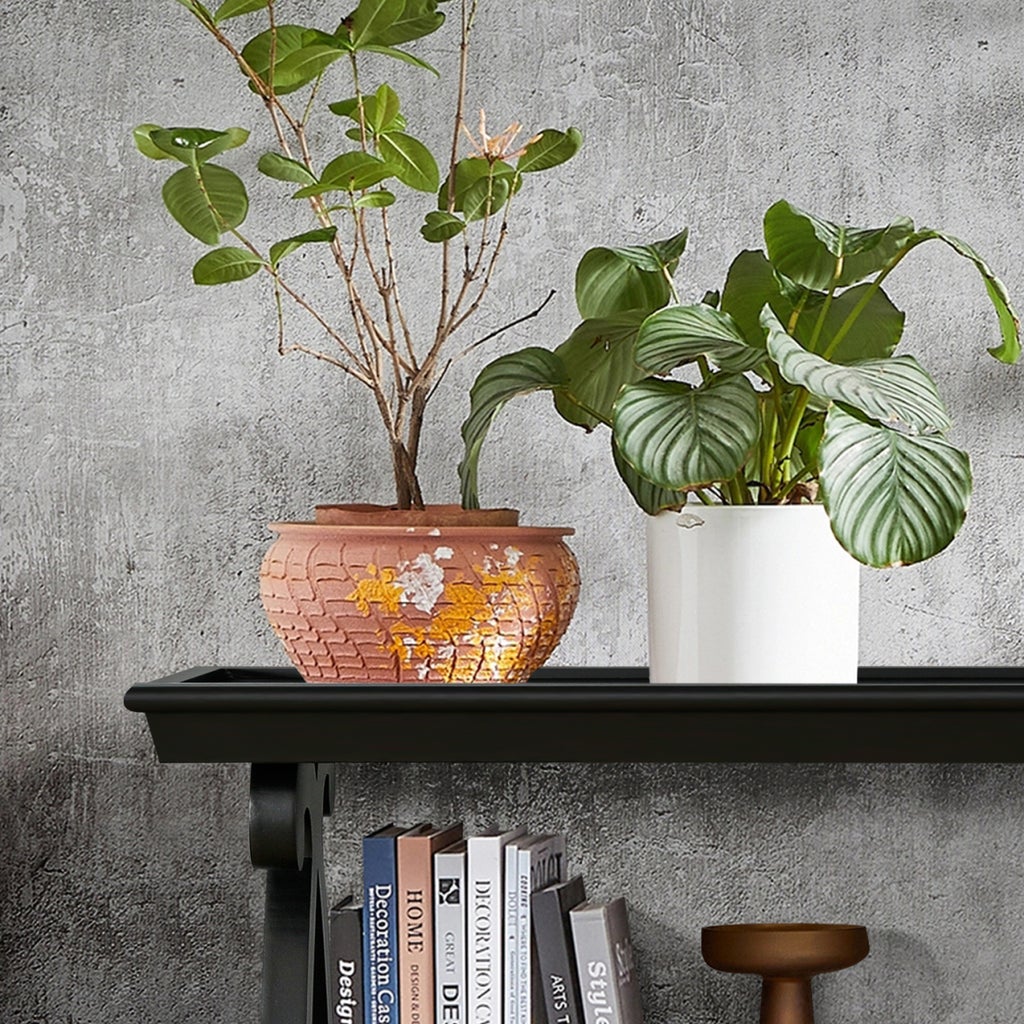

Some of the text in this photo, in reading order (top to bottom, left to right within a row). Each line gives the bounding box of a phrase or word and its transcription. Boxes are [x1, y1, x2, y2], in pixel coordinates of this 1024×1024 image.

[375, 884, 393, 986] Decoration
[407, 889, 423, 953] HOME
[475, 881, 491, 1000] DECORATION
[444, 931, 455, 973] GREAT
[410, 964, 420, 1001] DESIGN
[550, 974, 568, 1011] ARTS
[411, 1003, 420, 1011] &
